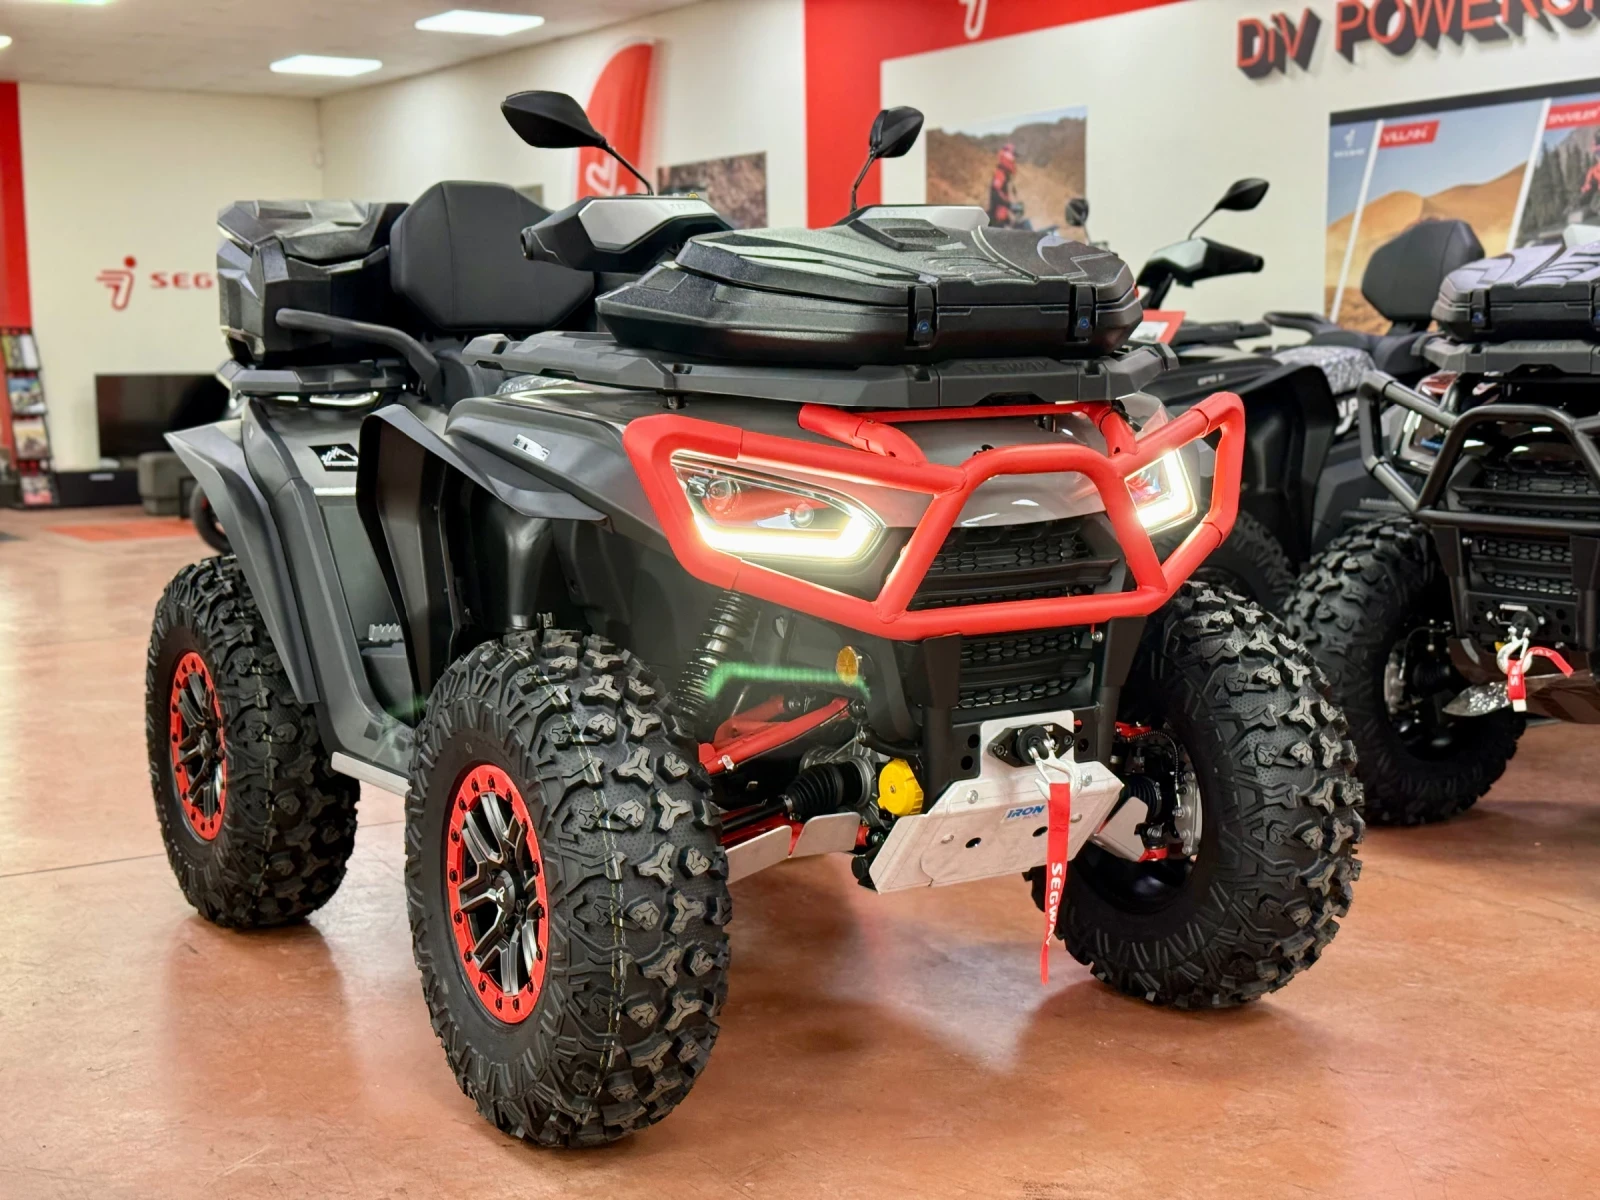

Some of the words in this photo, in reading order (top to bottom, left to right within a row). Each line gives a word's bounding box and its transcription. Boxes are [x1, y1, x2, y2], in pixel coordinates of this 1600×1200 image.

[1336, 0, 1595, 53] POWE
[962, 361, 1049, 375] SEGWAY
[1006, 805, 1045, 818] IRON
[1045, 862, 1063, 946] SEGWAY
